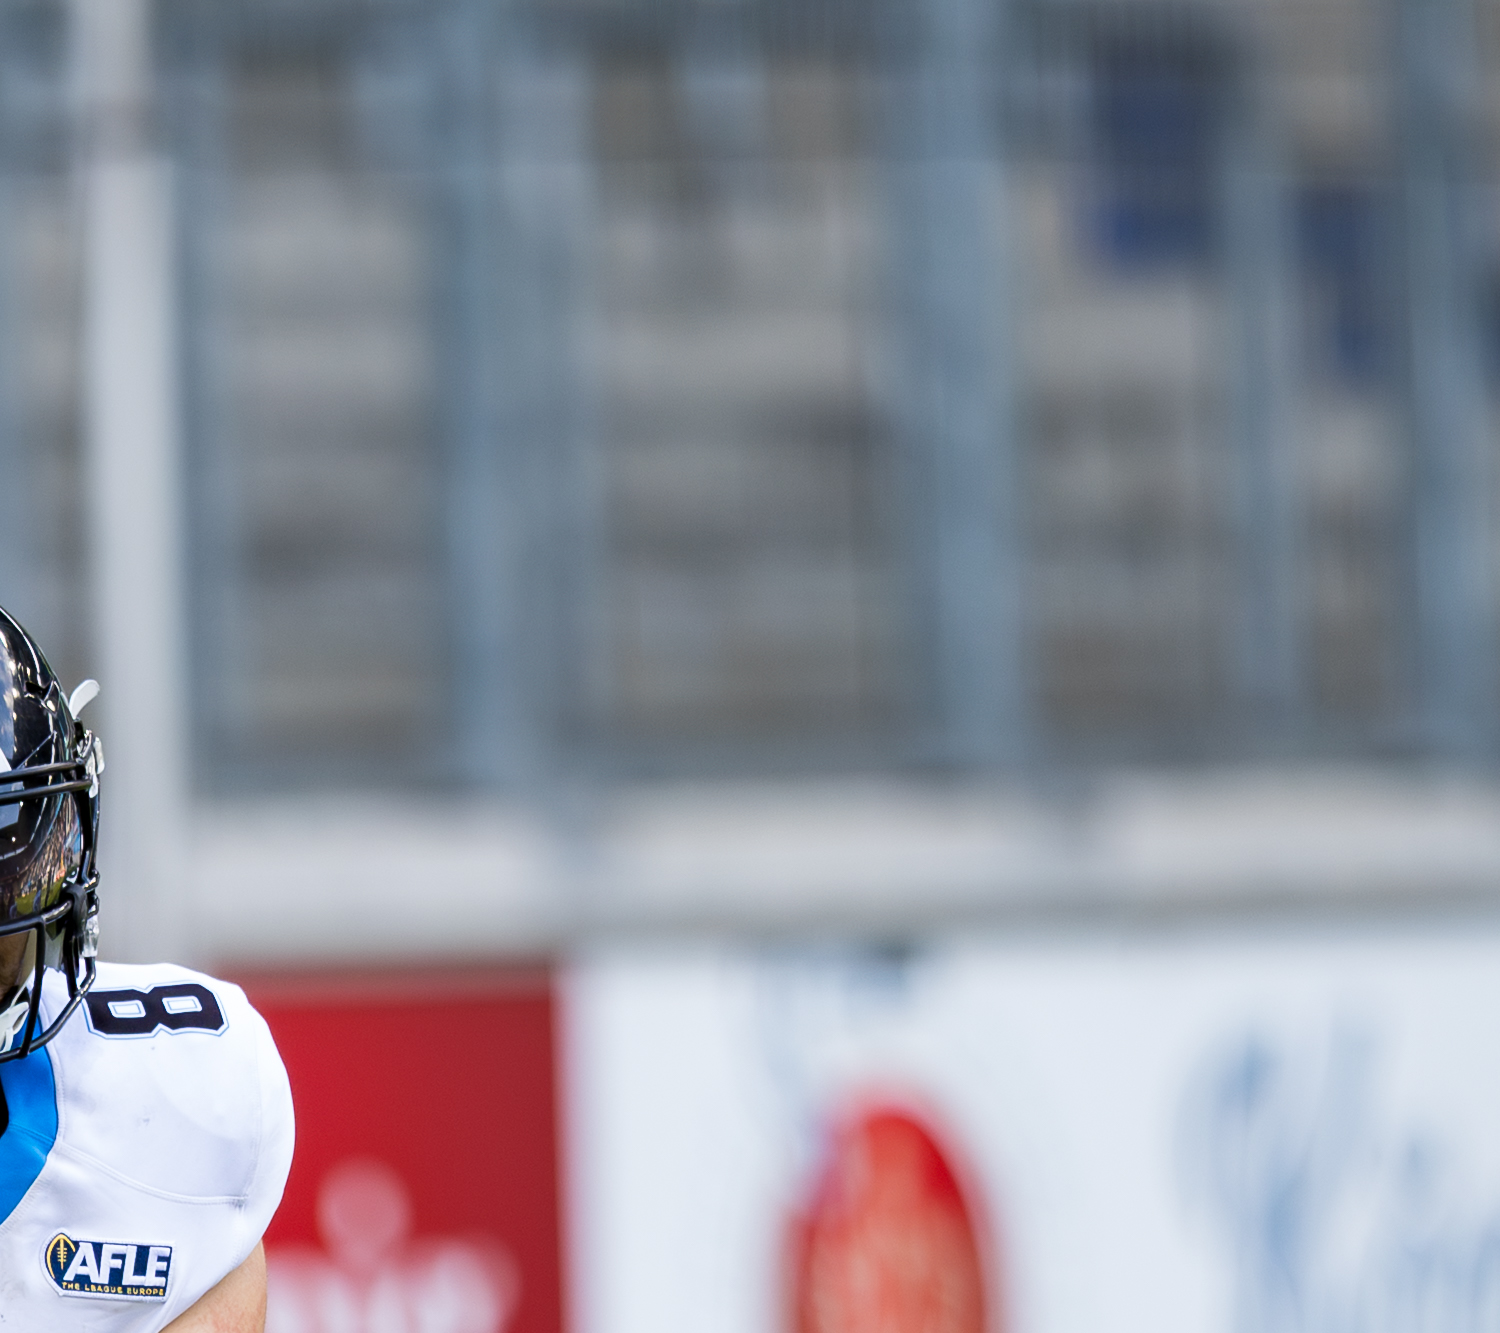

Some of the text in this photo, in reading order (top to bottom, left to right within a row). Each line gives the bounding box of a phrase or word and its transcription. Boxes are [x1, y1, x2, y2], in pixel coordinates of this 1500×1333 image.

[83, 981, 230, 1038] 8
[63, 1241, 172, 1288] AFLE
[61, 1281, 165, 1297] THE LEAGUE EUROPE
